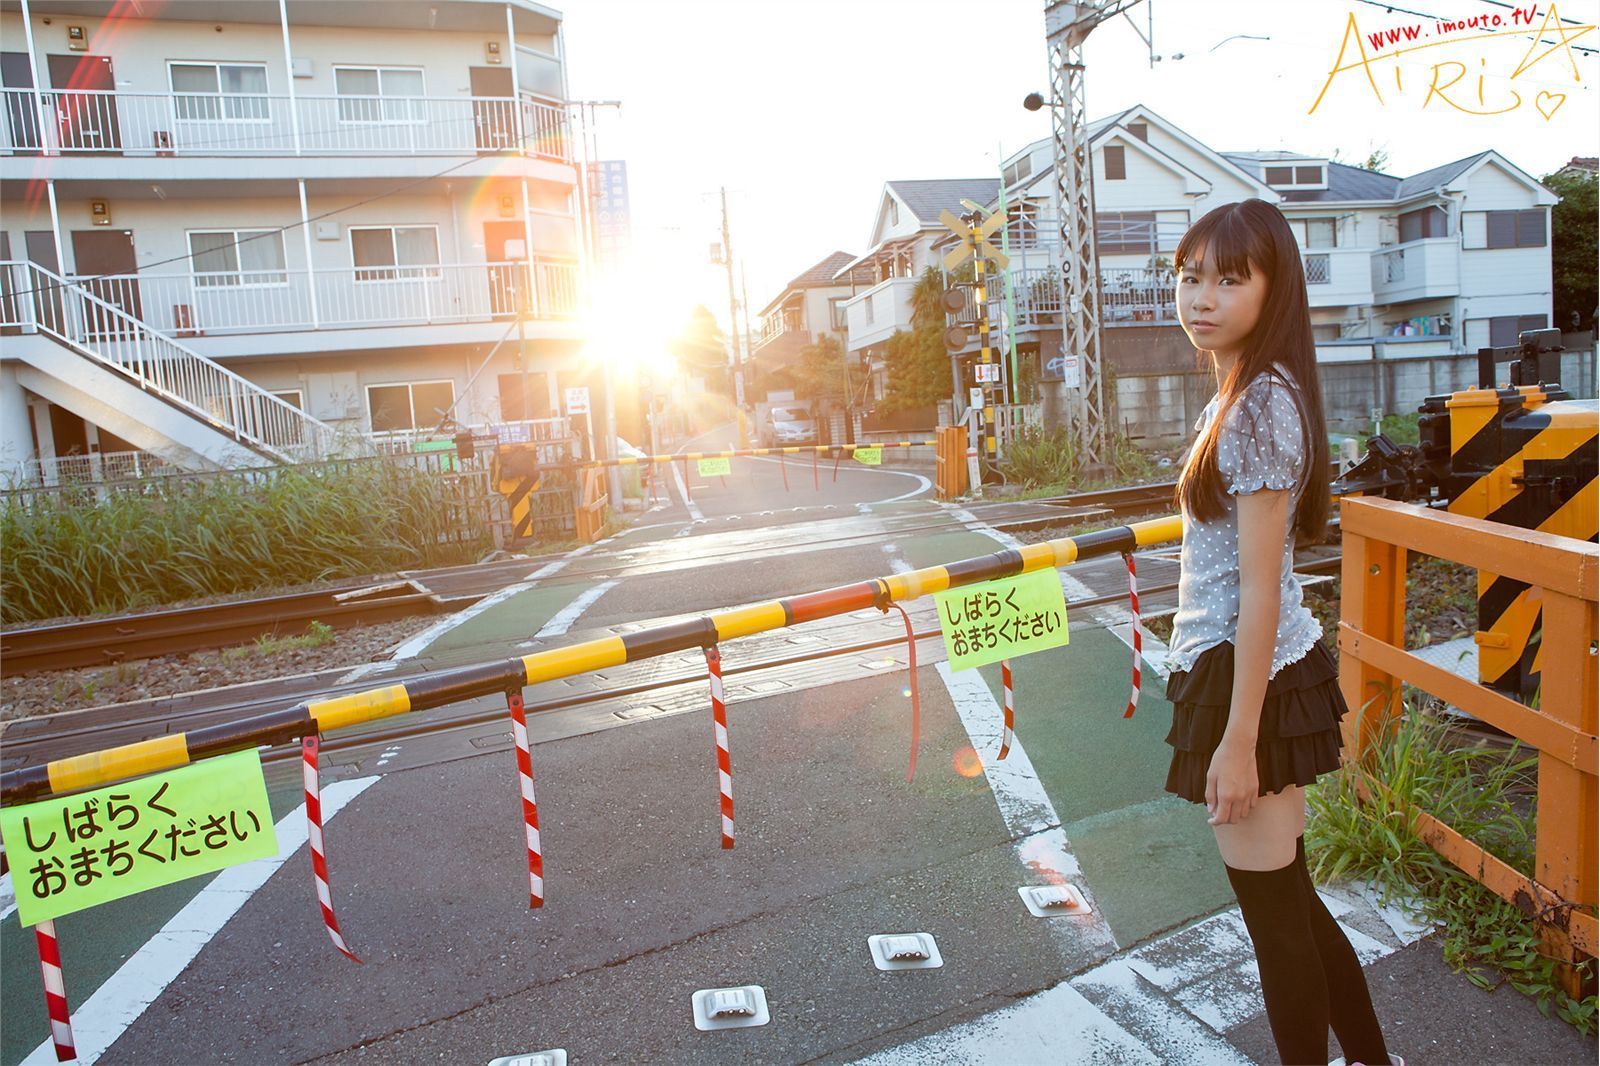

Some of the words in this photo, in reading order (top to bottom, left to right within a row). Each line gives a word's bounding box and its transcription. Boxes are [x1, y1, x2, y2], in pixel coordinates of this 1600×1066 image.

[944, 586, 1021, 627] しばらく
[951, 610, 1061, 657] おまちください
[23, 782, 178, 853] しばらく
[29, 809, 262, 899] おまちください
